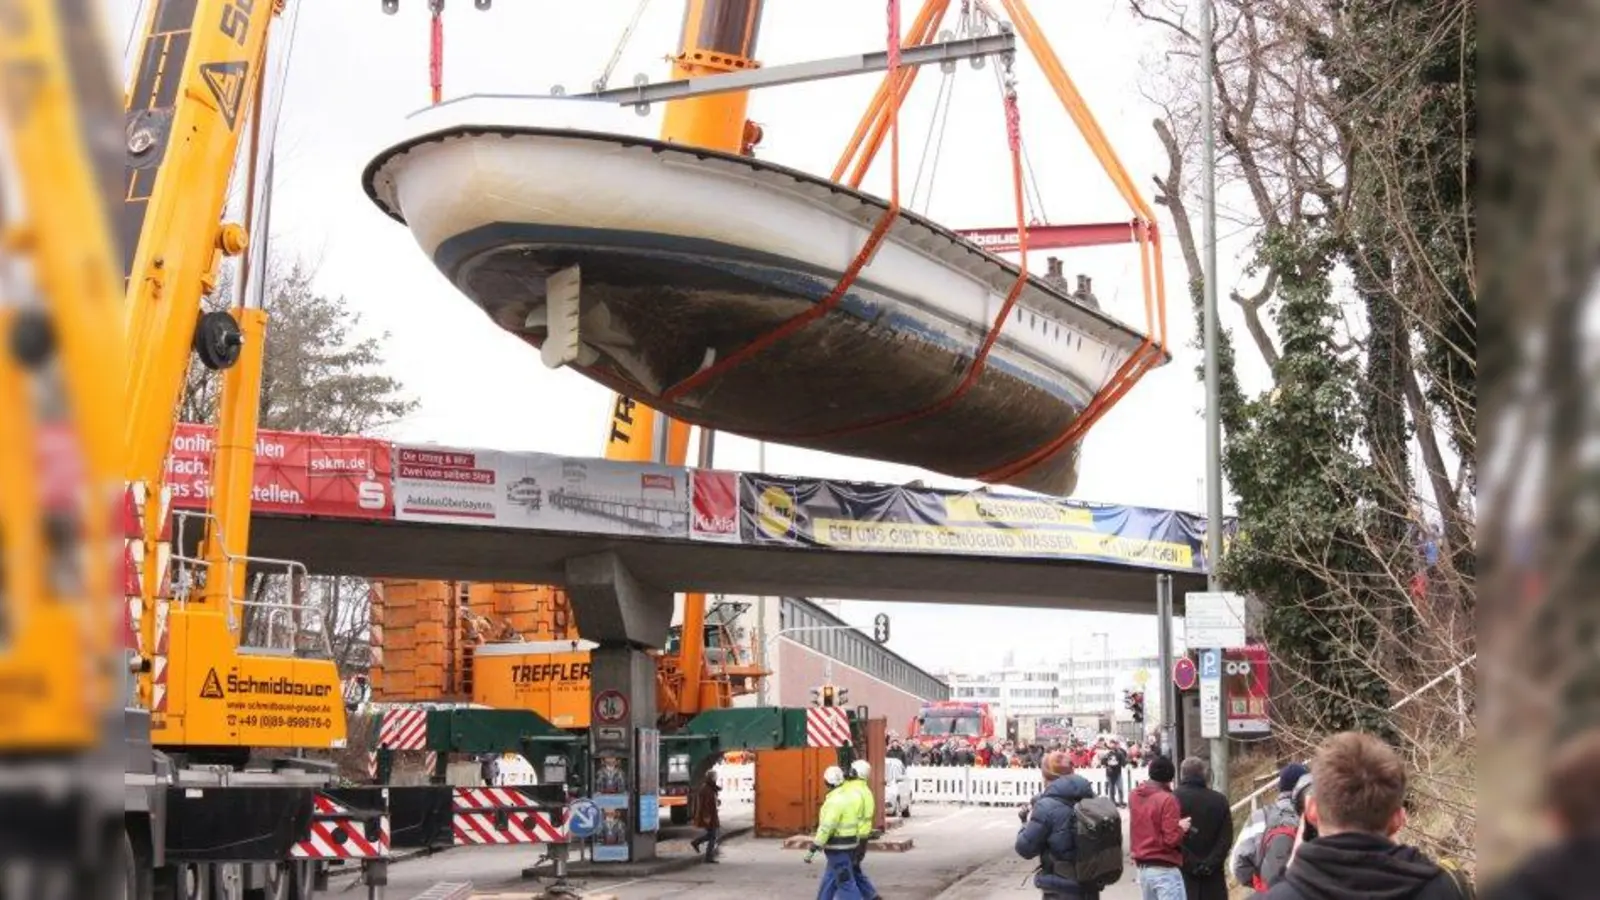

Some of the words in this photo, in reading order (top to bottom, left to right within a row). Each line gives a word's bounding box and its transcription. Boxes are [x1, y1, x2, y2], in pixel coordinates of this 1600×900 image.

[165, 455, 209, 475] fach.
[311, 456, 365, 470] sskm.de
[250, 484, 304, 504] tellen.
[512, 663, 591, 682] TREFFLER
[1203, 651, 1215, 676] P
[227, 674, 332, 697] Schmidbauer
